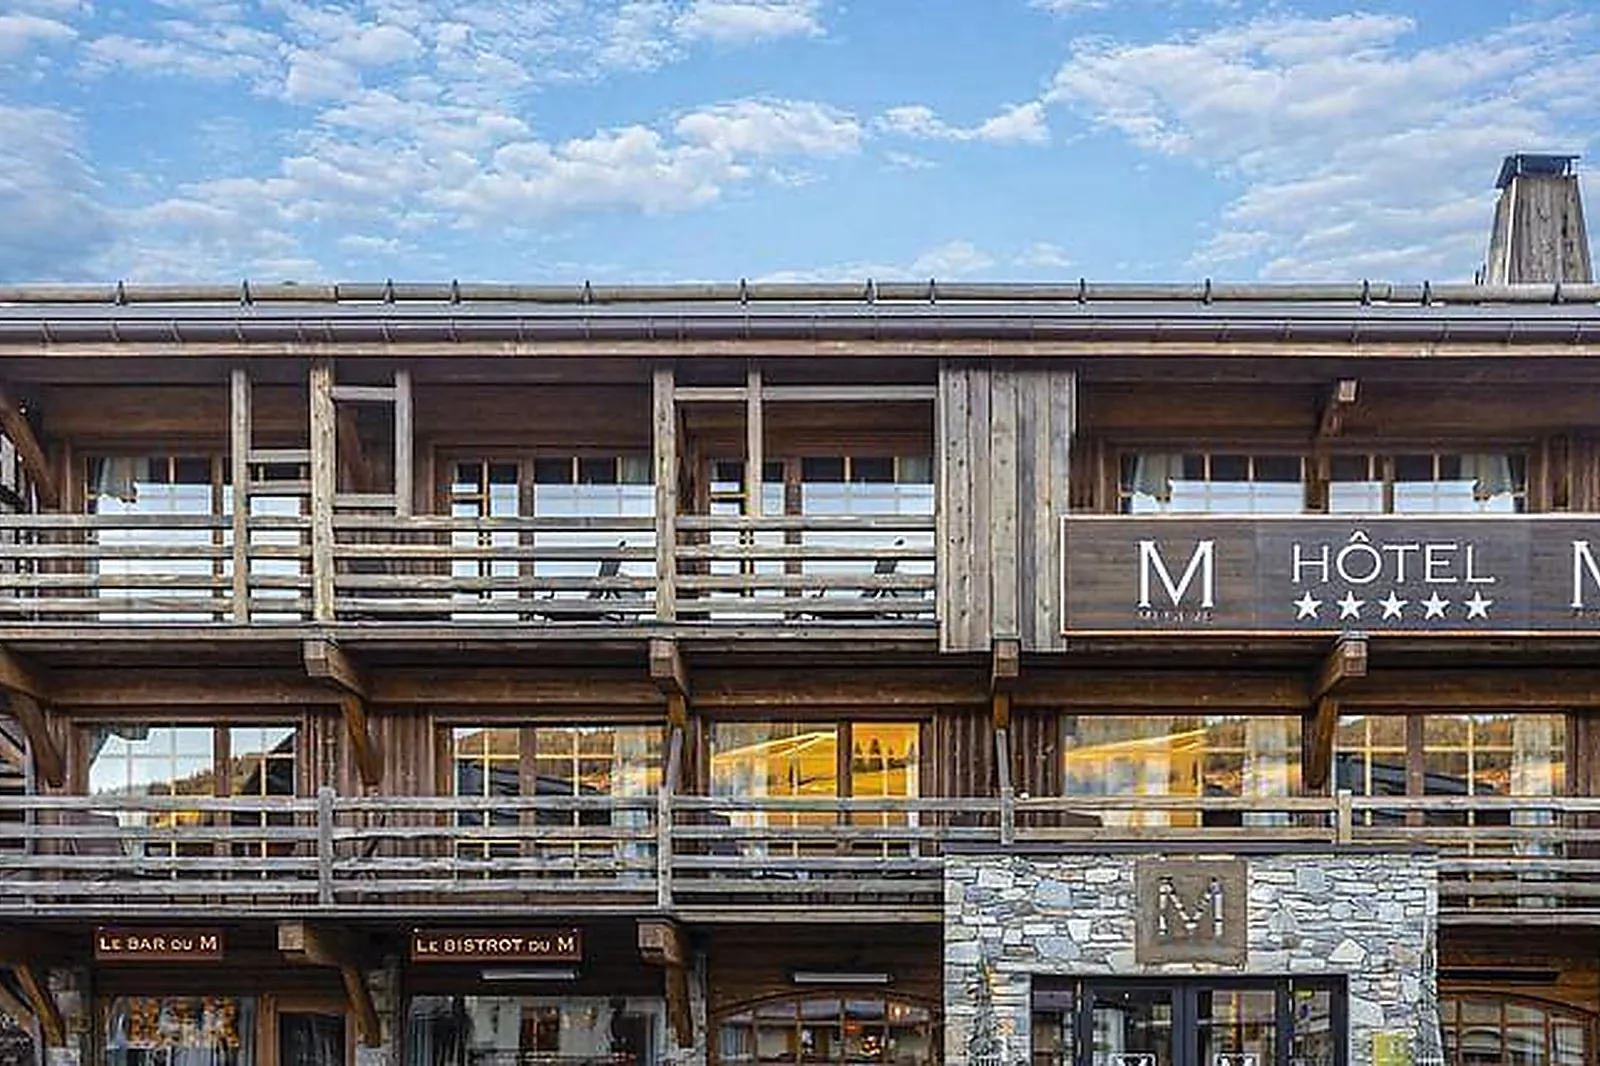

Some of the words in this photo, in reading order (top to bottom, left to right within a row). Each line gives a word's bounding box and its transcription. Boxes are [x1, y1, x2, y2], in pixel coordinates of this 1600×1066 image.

[1137, 540, 1216, 610] M
[1291, 531, 1496, 585] HÔTEL
[1158, 876, 1224, 936] M
[127, 937, 166, 950] BAR
[200, 935, 218, 950] M
[443, 938, 523, 953] BISTROT
[528, 940, 550, 953] DU
[557, 936, 575, 952] M
